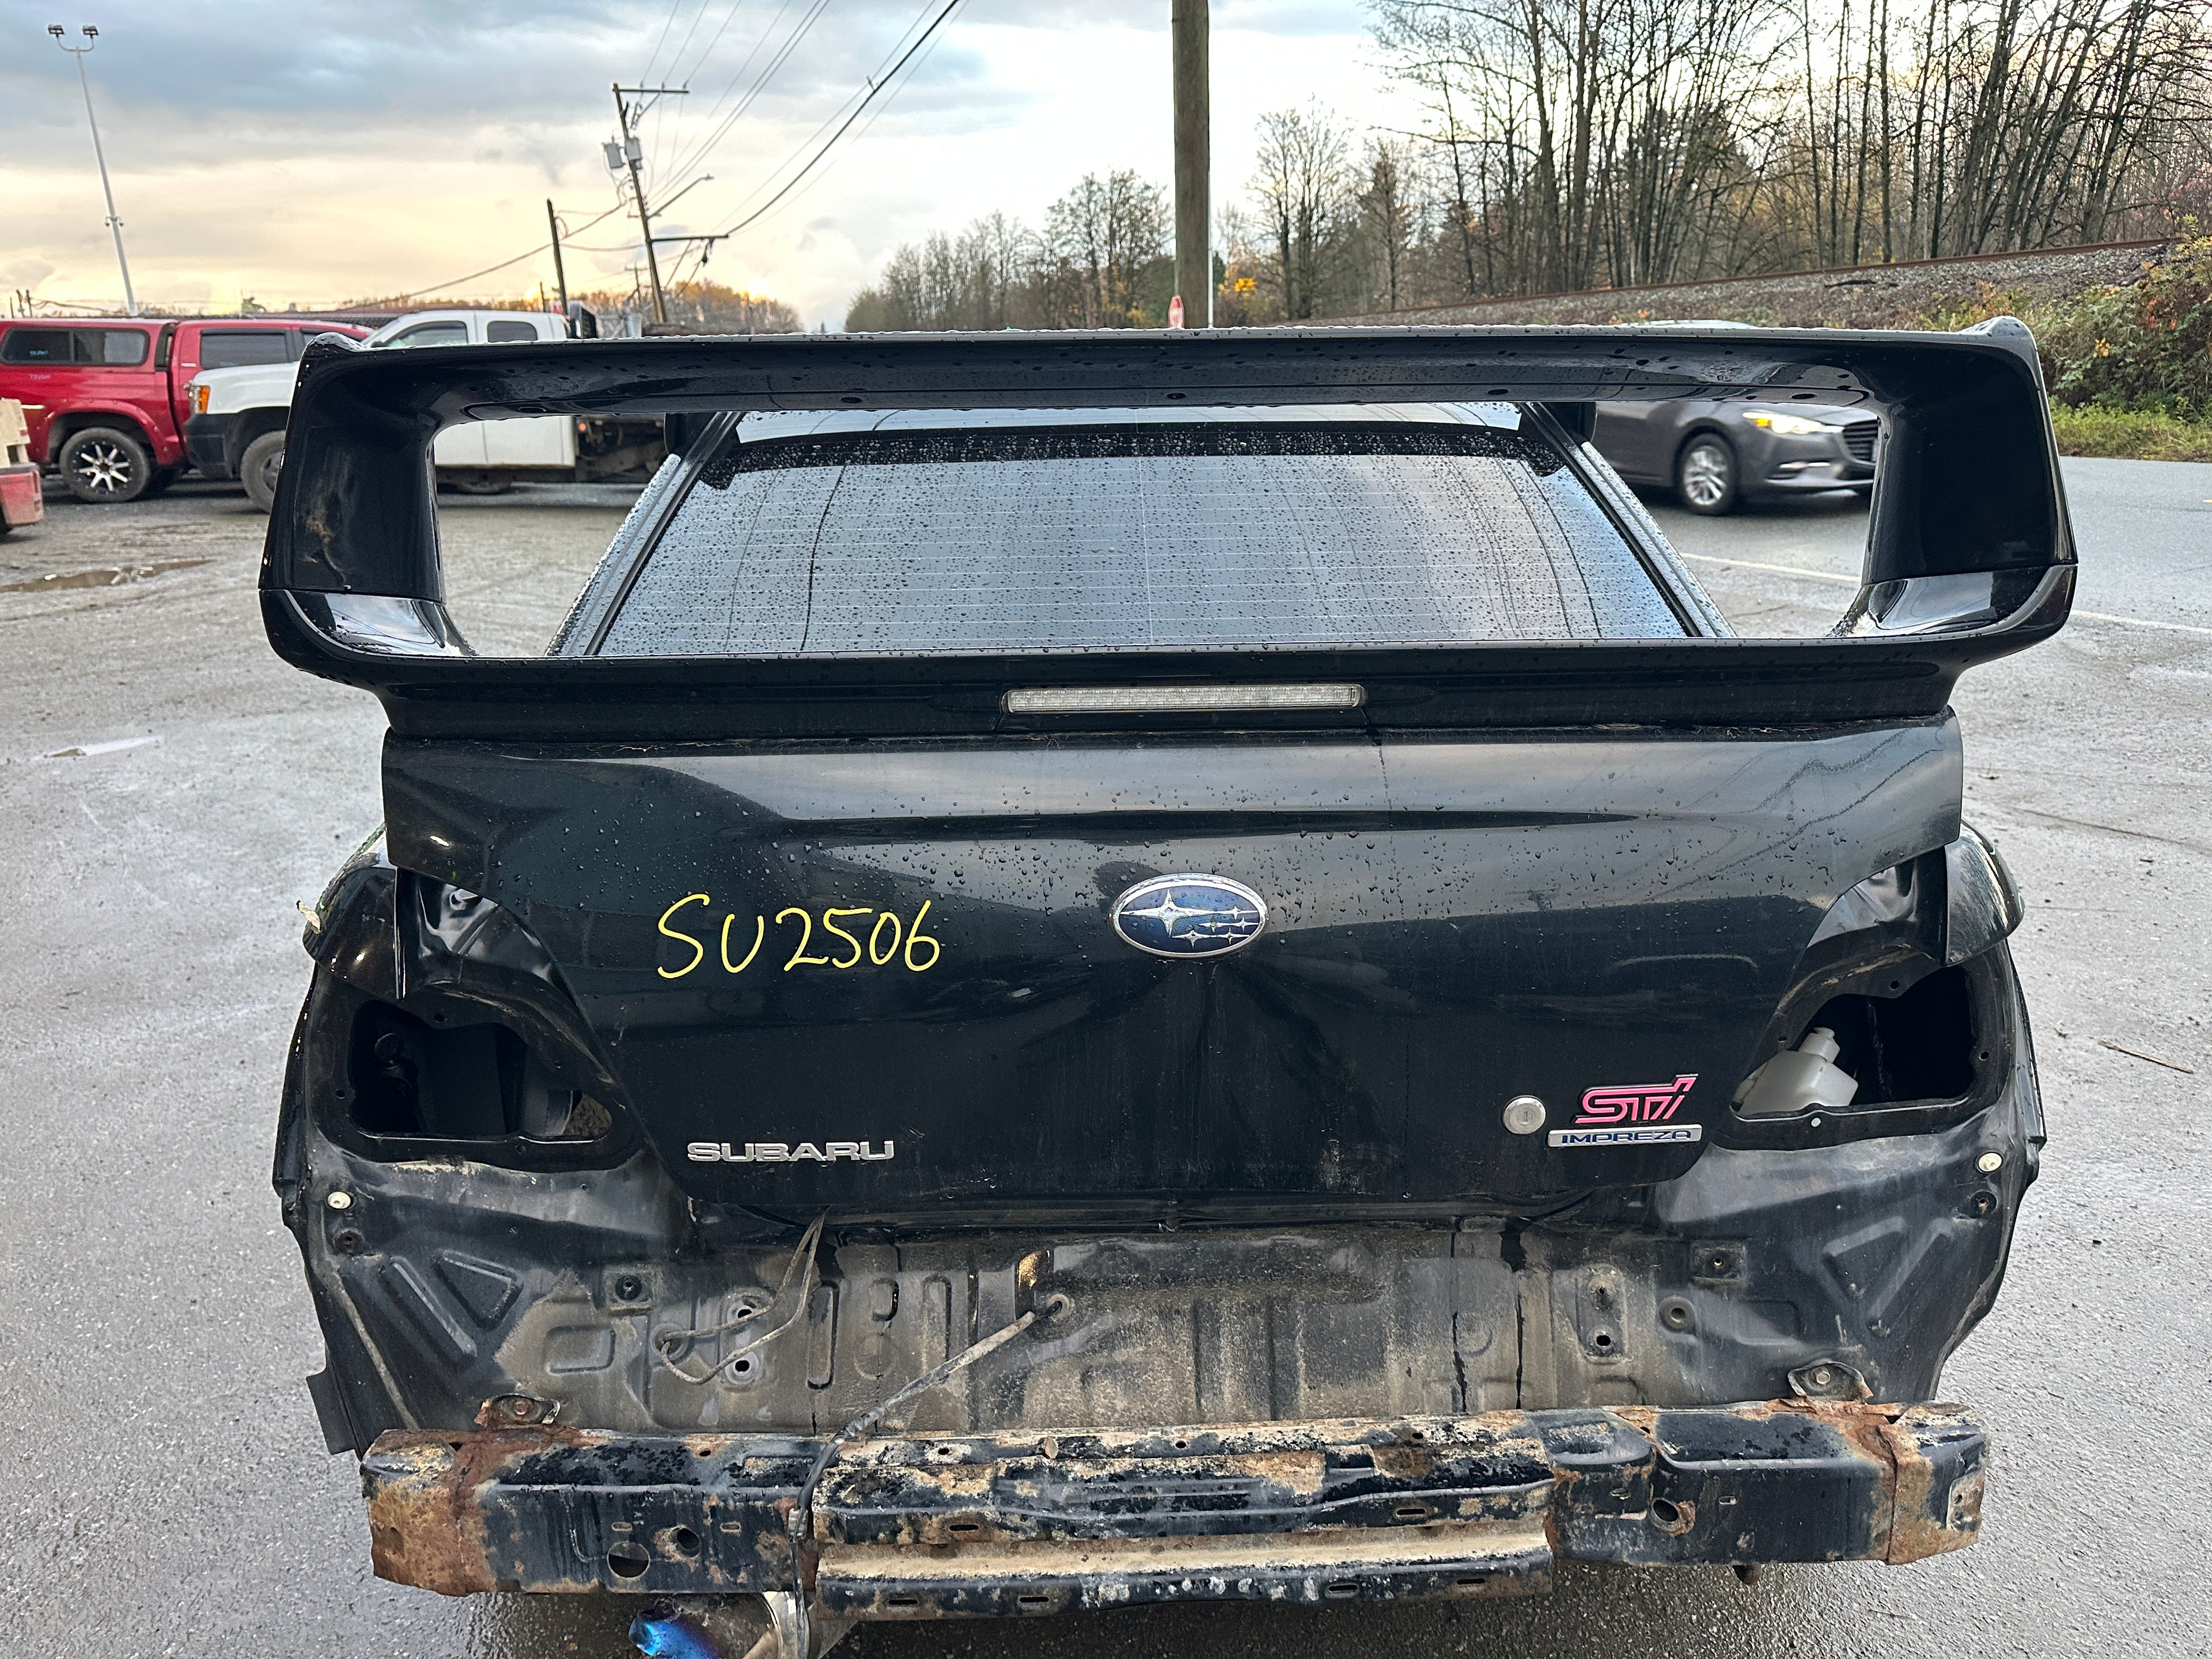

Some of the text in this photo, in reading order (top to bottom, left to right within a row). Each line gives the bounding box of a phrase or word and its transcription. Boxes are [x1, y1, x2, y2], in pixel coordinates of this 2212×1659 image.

[657, 893, 940, 979] SU2506
[1562, 1130, 1691, 1146] IMPREZA
[687, 1140, 895, 1162] SUBARU
